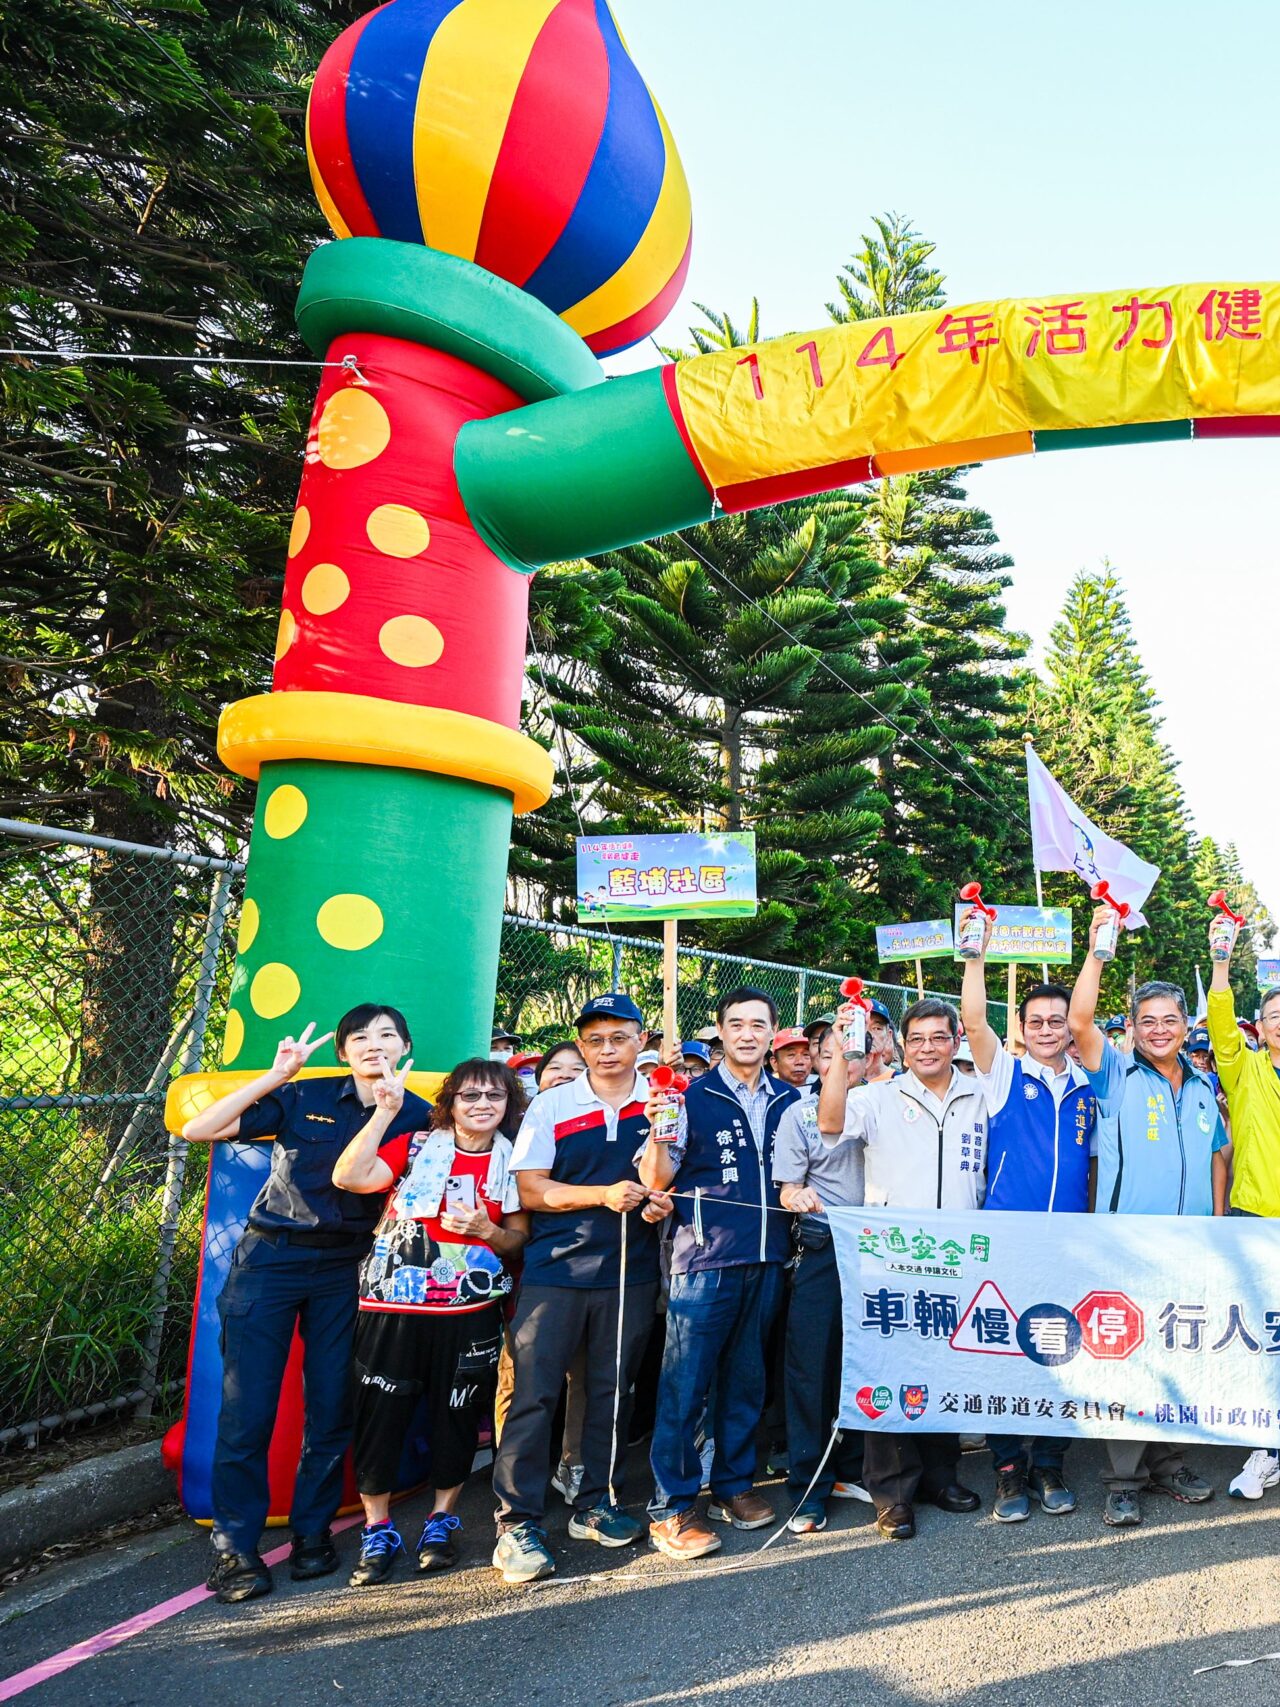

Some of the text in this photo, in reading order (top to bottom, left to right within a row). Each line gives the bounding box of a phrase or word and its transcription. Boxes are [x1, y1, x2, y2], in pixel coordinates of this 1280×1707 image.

[608, 866, 726, 896] 藍埔社區
[715, 1129, 739, 1184] 徐永興
[972, 1122, 983, 1172] 觀音區長
[858, 1226, 990, 1266] 交通安全月
[889, 1264, 922, 1274] 人本交通
